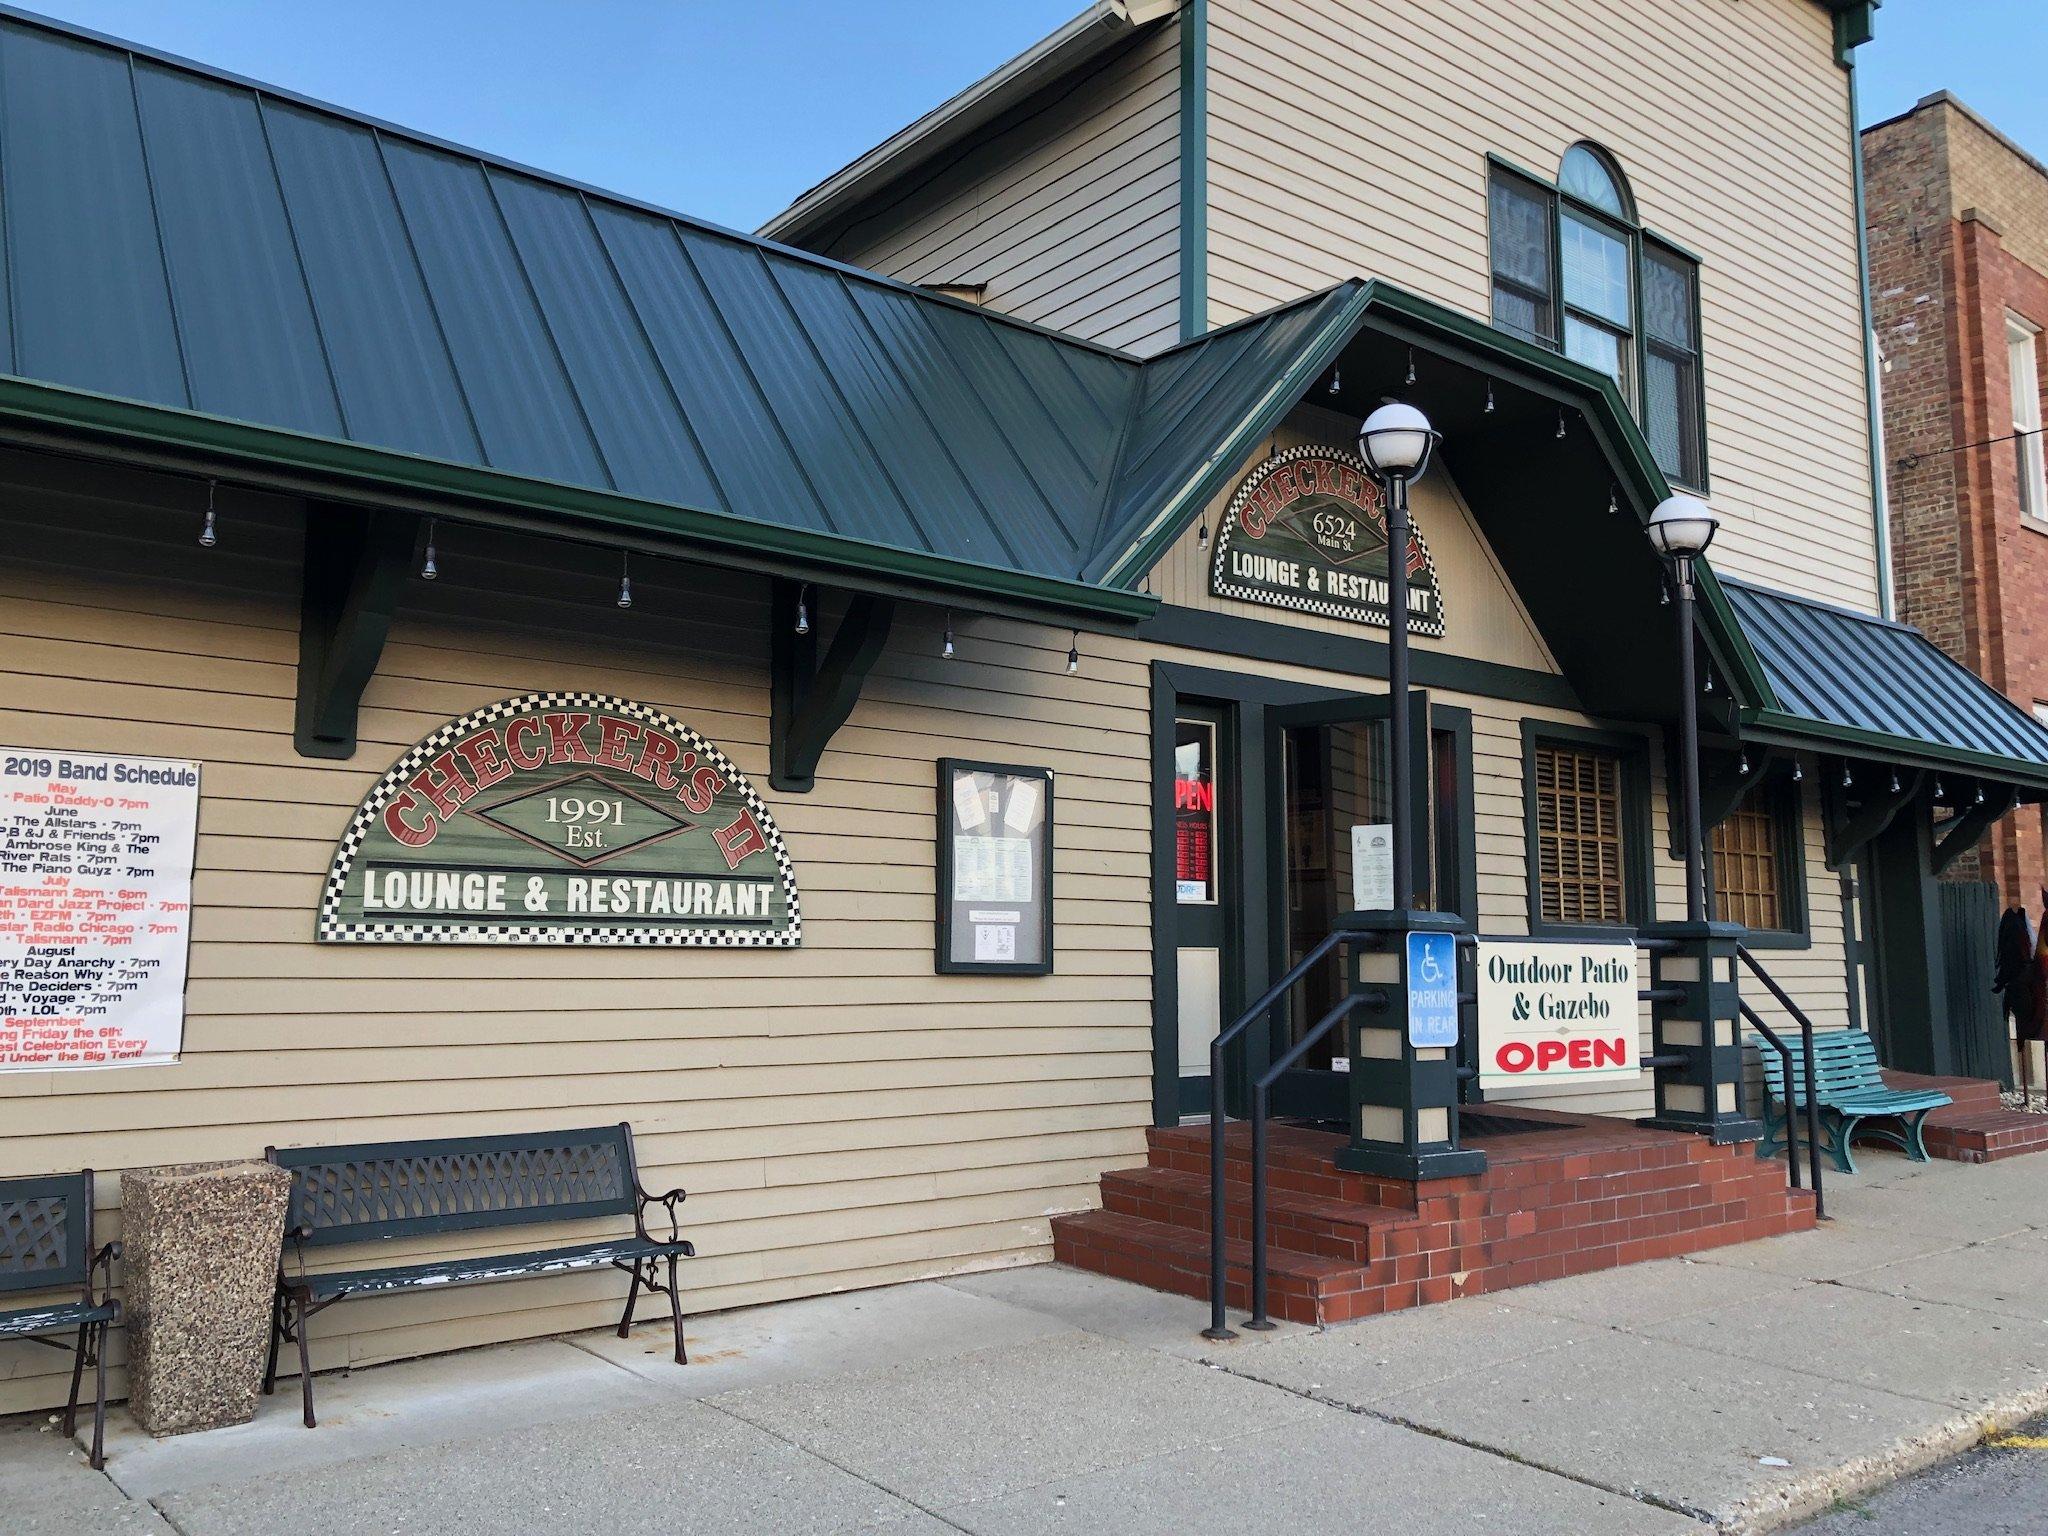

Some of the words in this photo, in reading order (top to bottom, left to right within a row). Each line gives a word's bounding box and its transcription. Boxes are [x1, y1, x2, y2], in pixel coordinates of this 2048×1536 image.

[1239, 460, 1389, 540] CHECKER'
[1313, 512, 1356, 540] 6524
[1317, 534, 1340, 549] Main
[1232, 551, 1300, 588] LOUNGE
[1307, 567, 1320, 592] &
[1327, 570, 1431, 613] RESTAUNT
[4, 757, 52, 778] 2019
[58, 760, 108, 781] Band
[114, 763, 197, 787] Schedule
[383, 712, 728, 848] CHECKER'S
[48, 783, 77, 795] May
[1175, 779, 1214, 812] PEN
[13, 792, 49, 804] Patio
[119, 799, 149, 810] 7pm
[44, 806, 78, 816] June
[544, 796, 626, 827] 1991
[14, 816, 40, 827] The
[44, 817, 96, 829] Allstars
[112, 821, 142, 832] 7pm
[50, 830, 58, 838] &
[63, 829, 116, 841] Friends
[130, 833, 160, 844] 7pm
[565, 824, 608, 849] Est.
[5, 839, 72, 851] Ambrose
[76, 841, 106, 854] King
[111, 843, 121, 853] &
[126, 844, 150, 854] The
[0, 851, 34, 861] River
[40, 852, 72, 863] Rats
[87, 854, 118, 865] 7pm
[2, 862, 28, 873] The
[32, 863, 72, 874] Piano
[78, 864, 112, 876] Guyz
[126, 866, 155, 878] 7pm
[42, 876, 70, 887] July
[72, 888, 104, 899] 2pm
[118, 889, 148, 900] 6pm
[364, 869, 506, 911] LOUNGE
[524, 875, 549, 913] &
[567, 877, 776, 917] RESTAURANT
[59, 900, 92, 910] Jazz
[97, 900, 145, 912] Project
[159, 901, 188, 912] 7pm
[86, 912, 116, 922] 7pm
[33, 922, 74, 932] Radio
[78, 922, 134, 935] Chicago
[148, 924, 178, 934] 7pm
[16, 933, 88, 944] Talismann
[102, 934, 132, 946] 7pm
[27, 946, 76, 957] August
[24, 958, 52, 970] Day
[58, 957, 115, 970] Anarchy
[130, 958, 160, 969] 7pm
[1488, 953, 1572, 984] Outdoor
[1580, 956, 1629, 984] Patio
[14, 970, 69, 980] Reason
[74, 970, 103, 980] Why
[118, 970, 148, 980] 7pm
[0, 982, 24, 992] The
[29, 982, 92, 992] Deciders
[107, 982, 138, 992] 7pm
[22, 994, 76, 1004] Voyage
[91, 994, 122, 1004] 7pm
[1411, 990, 1454, 1008] PARKING
[1512, 991, 1530, 1021] &
[1538, 992, 1610, 1020] Gazebo
[32, 1005, 60, 1016] LOL
[75, 1006, 106, 1016] 7pm
[5, 1017, 84, 1028] September
[22, 1028, 70, 1040] Friday
[74, 1028, 94, 1038] the
[22, 1039, 102, 1050] Celebration
[108, 1040, 148, 1051] Every
[10, 1052, 53, 1062] Under
[58, 1052, 79, 1062] the
[84, 1051, 106, 1062] Big
[1496, 1038, 1626, 1073] OPEN
